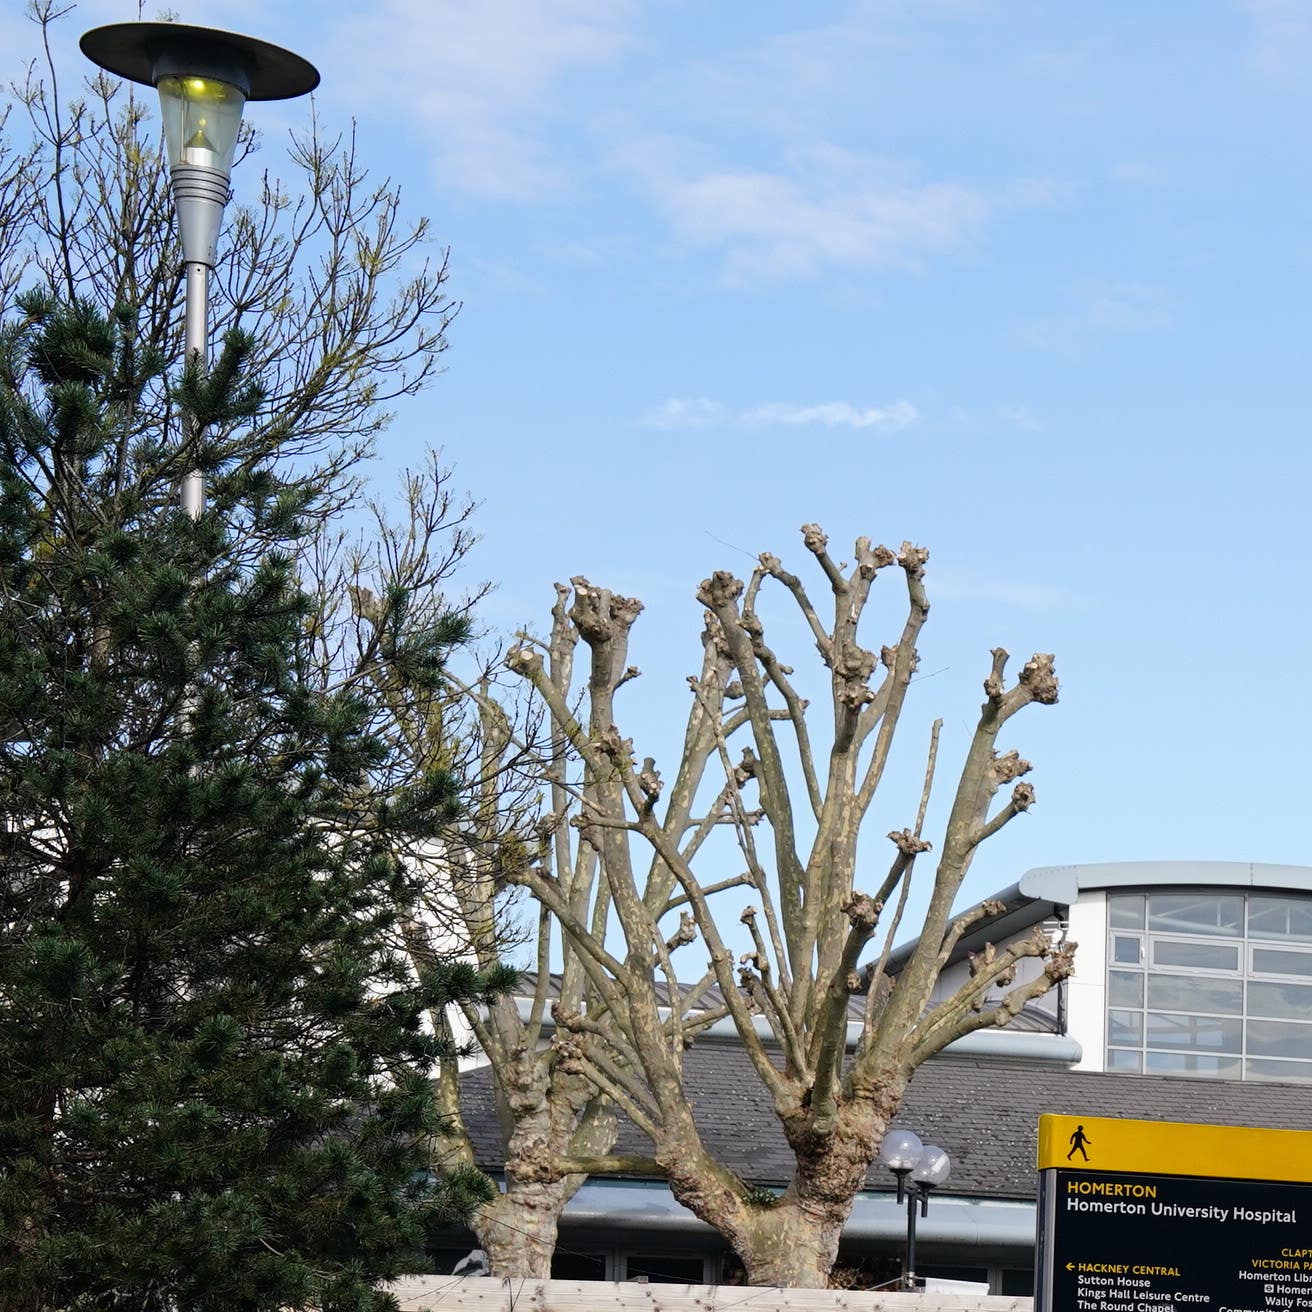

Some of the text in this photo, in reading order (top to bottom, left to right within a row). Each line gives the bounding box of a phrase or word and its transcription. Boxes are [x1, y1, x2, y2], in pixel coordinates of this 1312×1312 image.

[1067, 1181, 1156, 1198] HOMERTON
[1067, 1198, 1296, 1224] Homerton University Hospital
[1078, 1263, 1180, 1276] HACKNEY CENTRAL
[1251, 1259, 1301, 1270] VICTORIA
[1078, 1275, 1151, 1288] Sutton House
[1239, 1271, 1290, 1282] Homerton
[1077, 1288, 1210, 1303] Kings Hall Leisure Centre
[1077, 1300, 1097, 1311] The
[1100, 1302, 1134, 1312] Round
[1265, 1297, 1294, 1309] Wally
